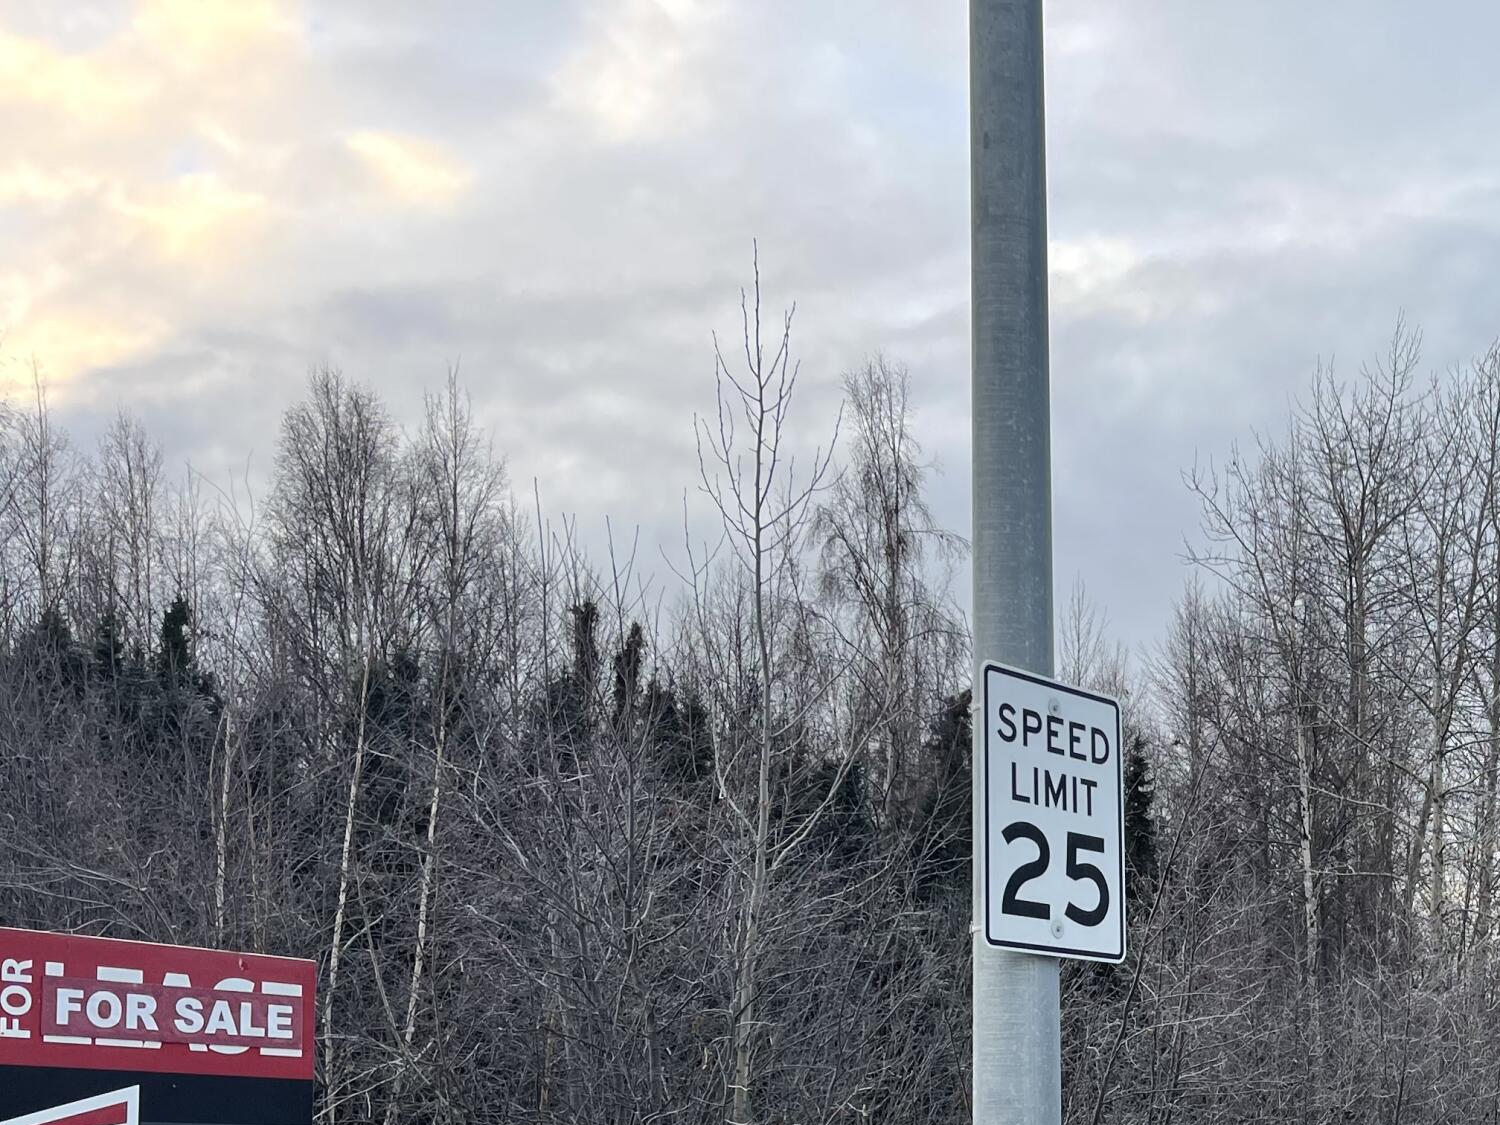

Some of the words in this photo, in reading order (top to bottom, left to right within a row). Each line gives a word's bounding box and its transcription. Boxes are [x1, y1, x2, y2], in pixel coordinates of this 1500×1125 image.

[997, 702, 1111, 765] SPEED
[1011, 761, 1098, 817] LIMIT
[1001, 821, 1110, 928] 25
[0, 958, 34, 1039] FOR
[55, 987, 159, 1030] FOR
[174, 997, 294, 1040] SALE
